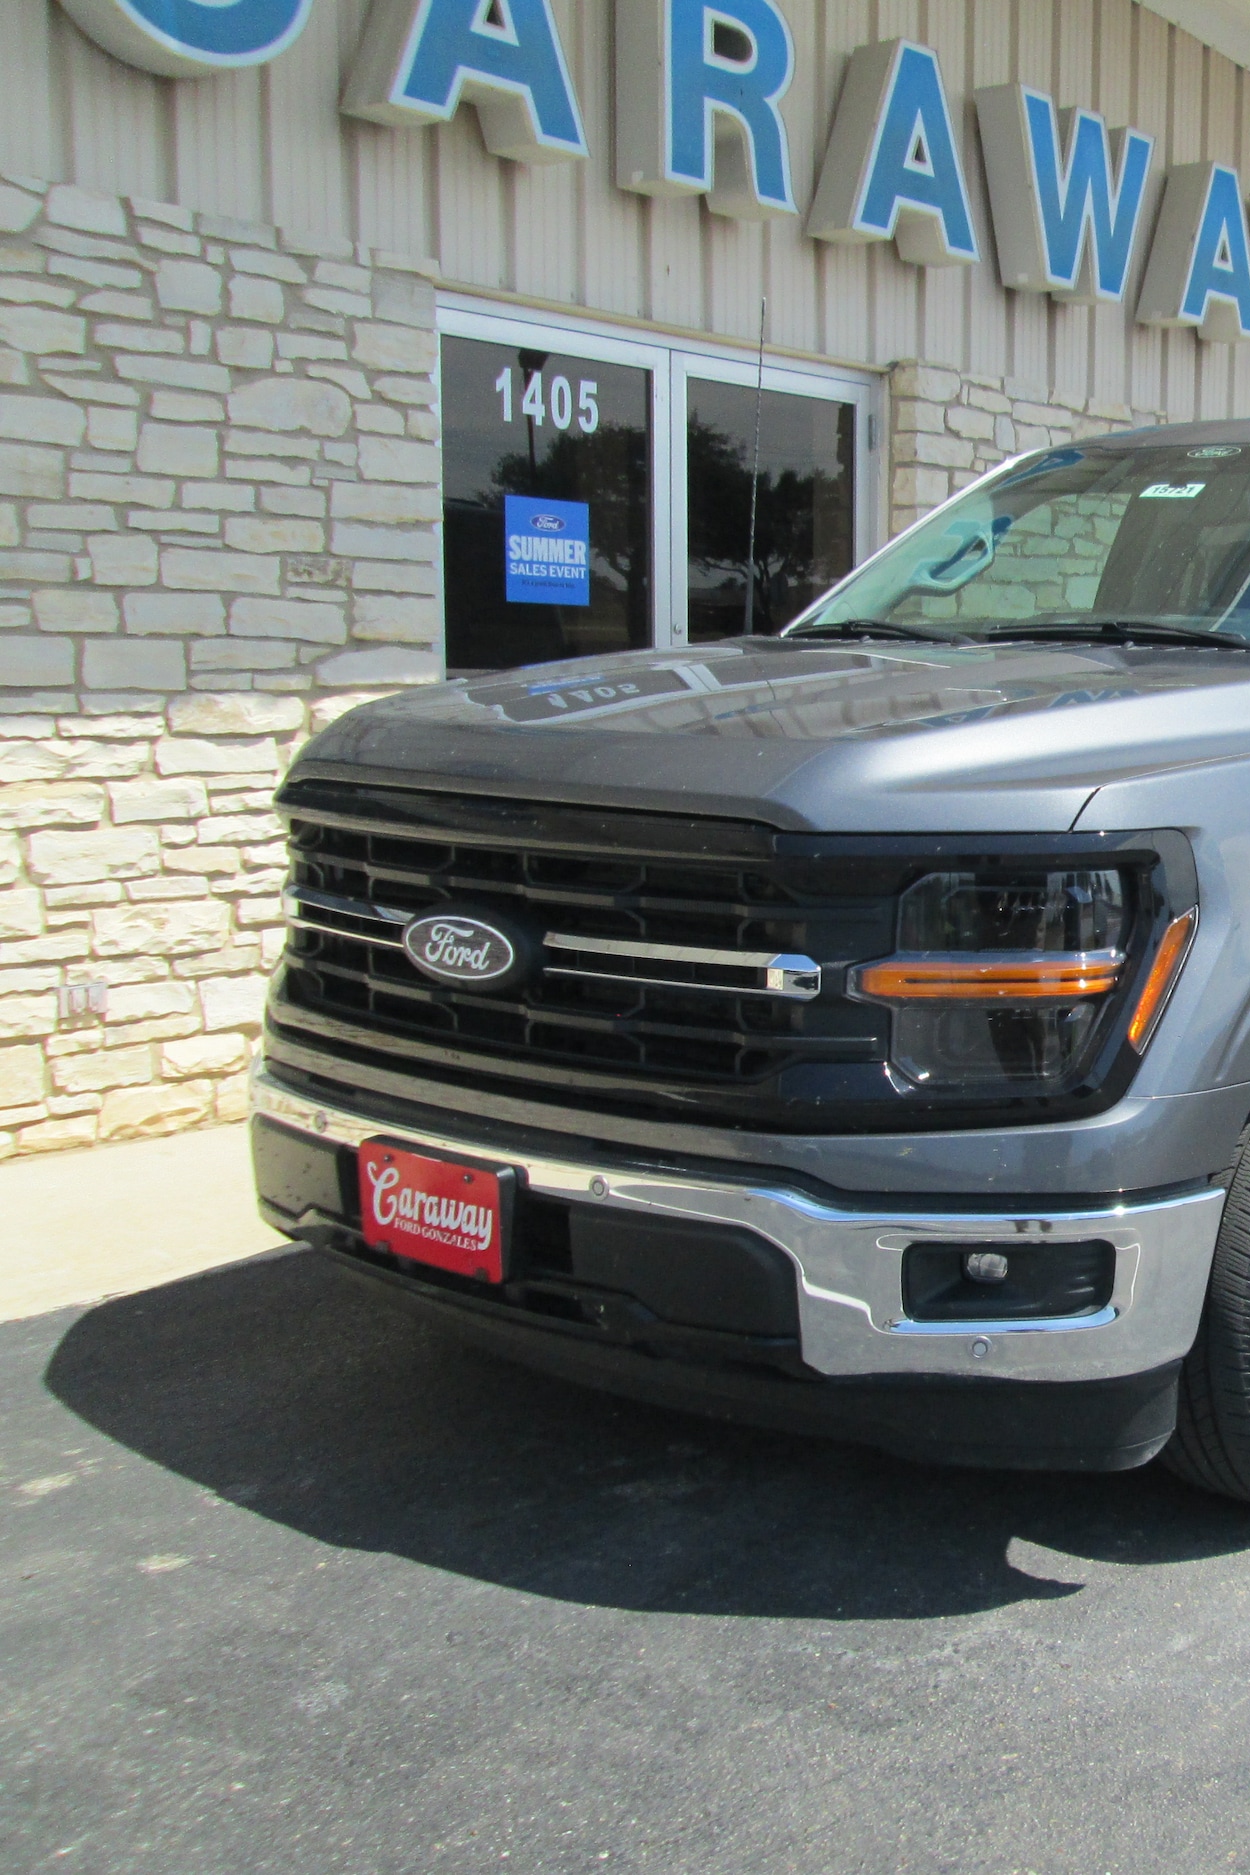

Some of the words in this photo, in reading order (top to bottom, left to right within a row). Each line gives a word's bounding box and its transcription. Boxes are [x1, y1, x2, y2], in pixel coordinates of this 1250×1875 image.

[496, 367, 599, 433] 1405
[536, 516, 560, 530] Ford
[509, 535, 587, 565] SUMMER
[510, 563, 547, 577] SALES
[549, 565, 586, 579] EVENT
[425, 923, 491, 970] Ford
[367, 1161, 492, 1250] Caraway
[394, 1217, 421, 1235] FORD
[421, 1226, 478, 1251] GONZALES
